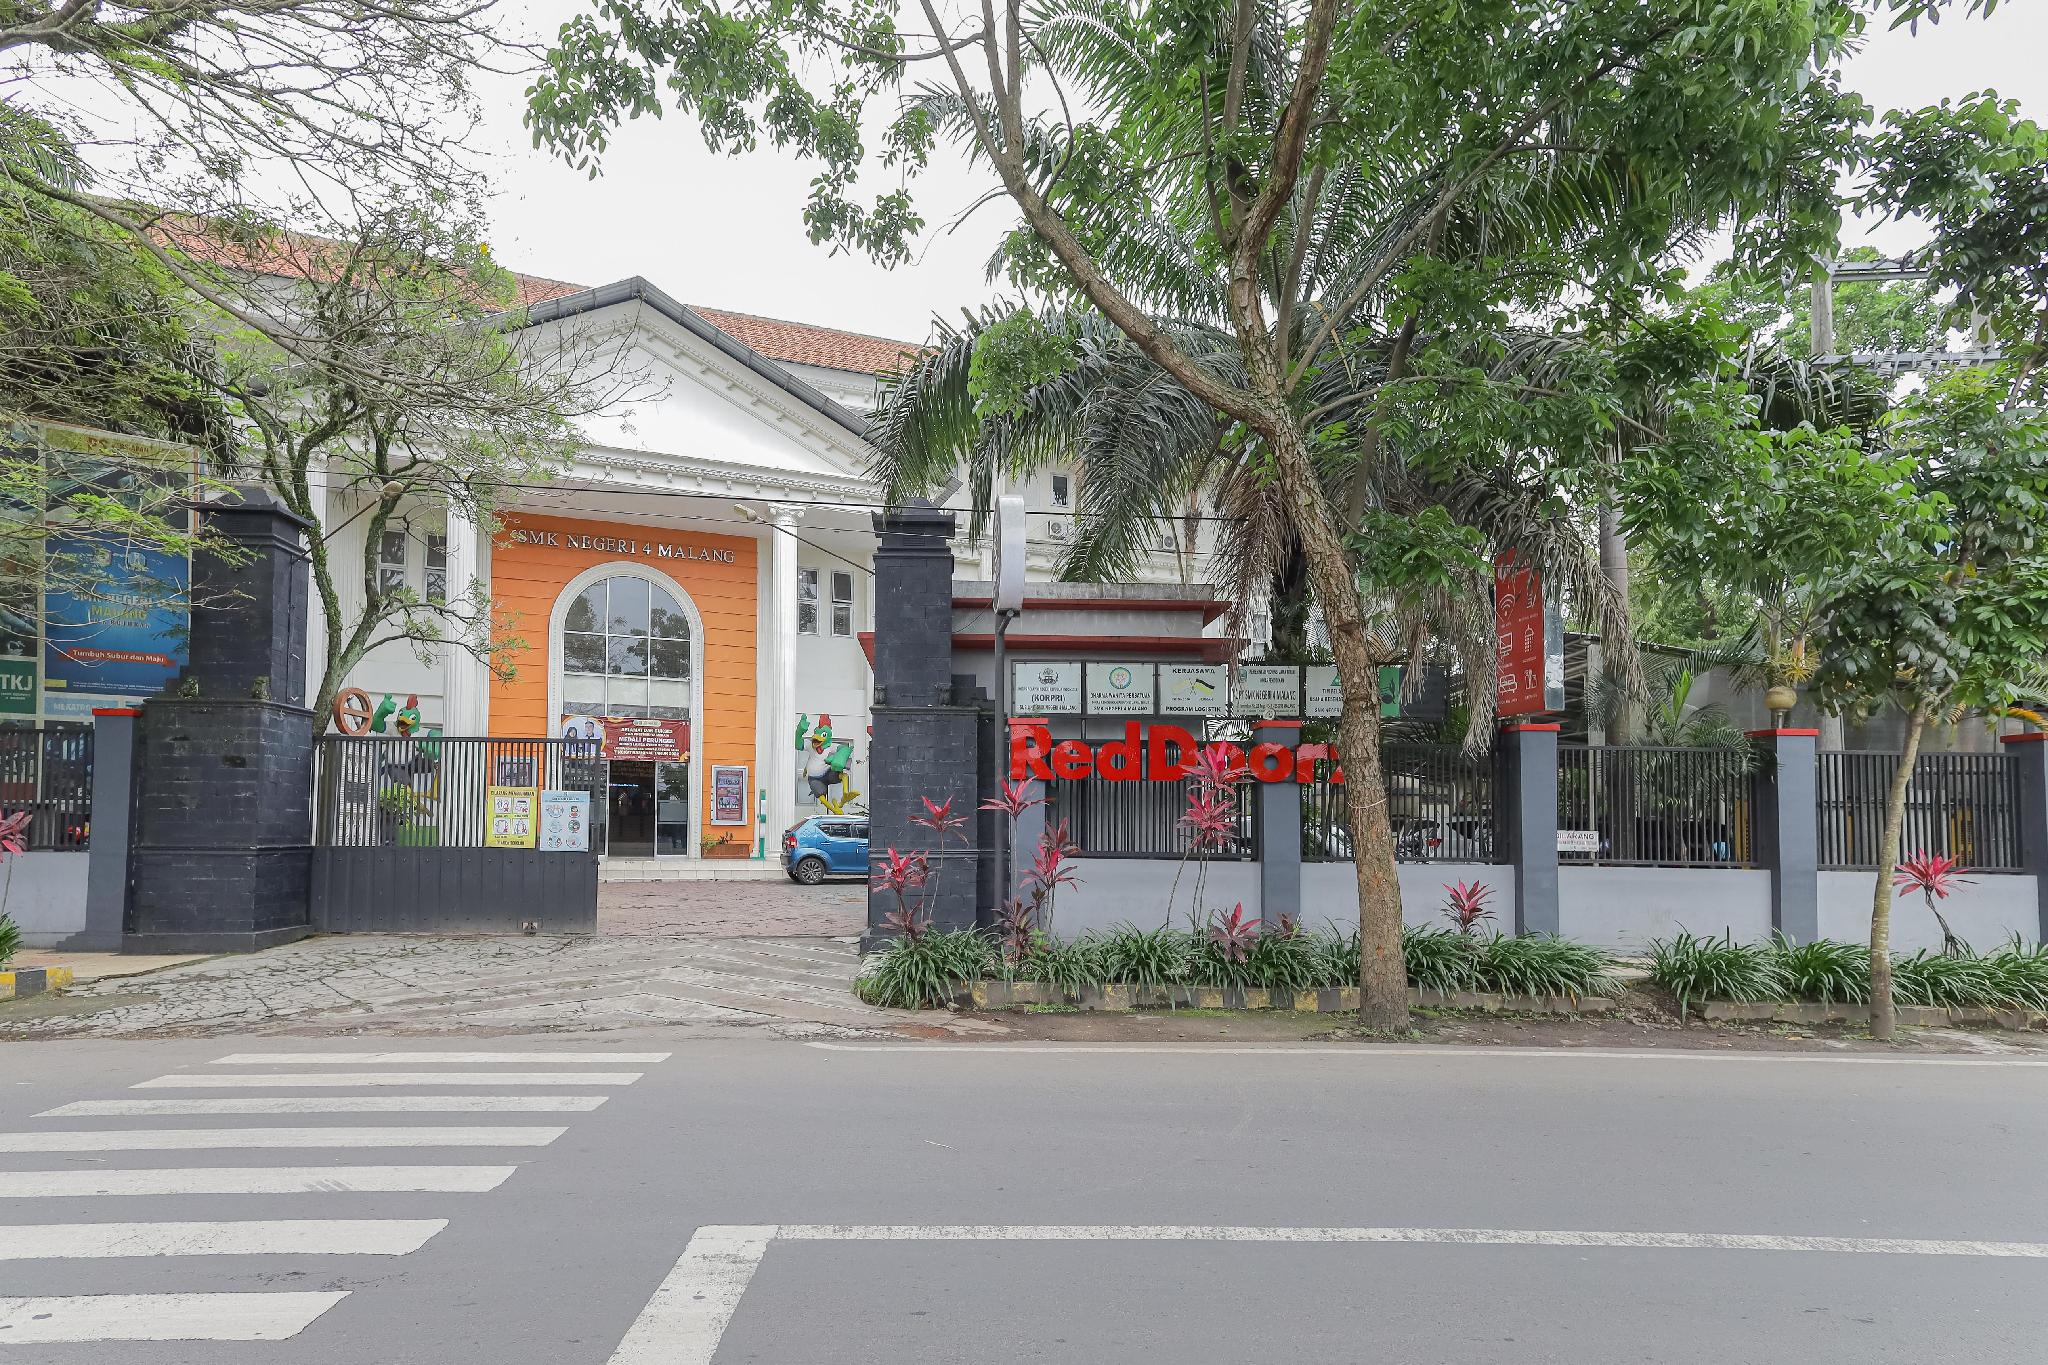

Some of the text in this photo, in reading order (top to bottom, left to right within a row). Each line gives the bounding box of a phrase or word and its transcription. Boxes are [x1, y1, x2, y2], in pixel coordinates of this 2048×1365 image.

[514, 529, 735, 564] SMK NEGERI 4 MALANG
[72, 649, 105, 659] Tumbuh
[106, 652, 129, 661] Subur
[145, 656, 164, 664] Maju
[0, 673, 33, 691] TKJ
[1031, 694, 1066, 703] (KORPRI)
